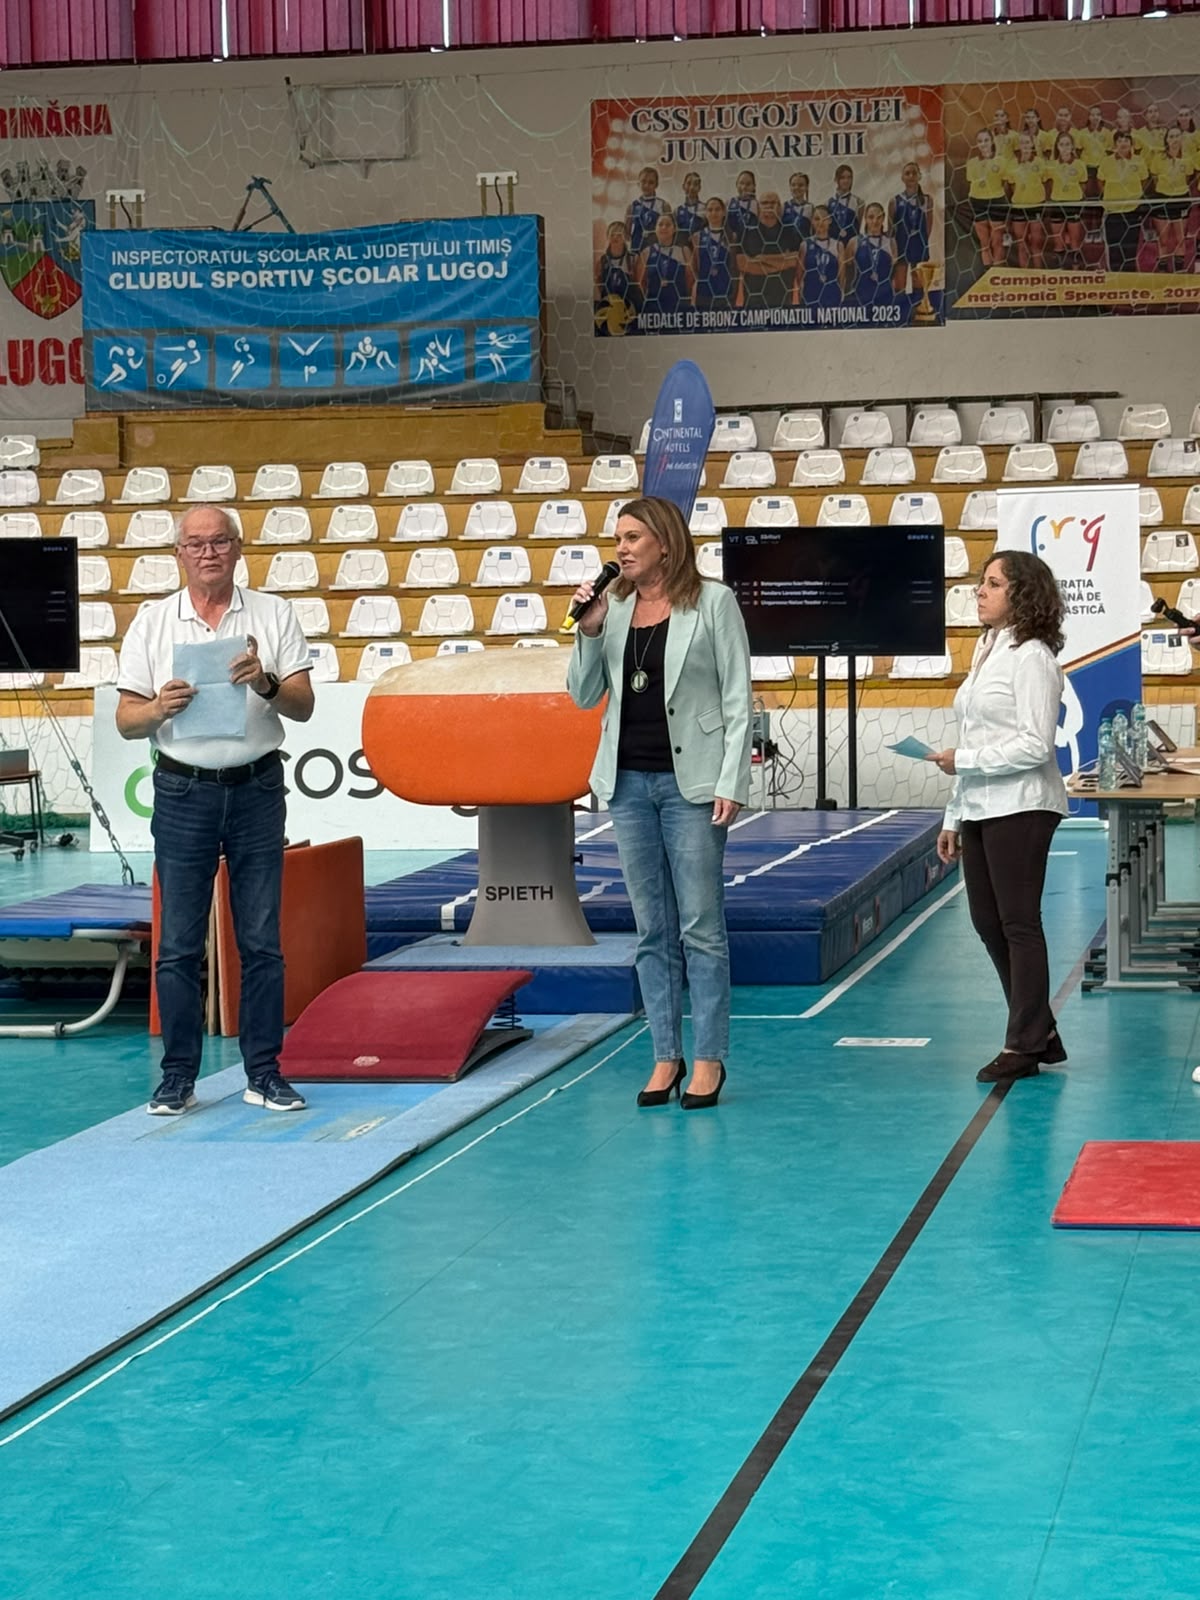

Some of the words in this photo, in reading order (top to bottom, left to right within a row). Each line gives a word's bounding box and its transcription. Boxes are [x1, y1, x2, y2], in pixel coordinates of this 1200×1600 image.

[631, 106, 689, 133] CSS
[697, 103, 801, 131] LUGOJ
[807, 98, 904, 126] VOLEI
[661, 133, 822, 164] JUNIOARE
[830, 132, 866, 156] III
[112, 250, 253, 265] INSPECTORATUL
[257, 247, 330, 268] ȘCOLAR
[334, 245, 358, 260] AL
[362, 241, 460, 262] JUDEȚULUI
[465, 239, 512, 257] TIMIȘ
[109, 271, 203, 290] CLUBUL
[210, 269, 314, 288] SPORTIV
[322, 265, 419, 292] ȘCOLAR
[427, 261, 509, 282] LUGOJ
[637, 312, 684, 329] MEDALIE
[686, 311, 702, 328] DE
[702, 310, 739, 327] BRONZ
[740, 307, 815, 327] CAMPIONATUL
[817, 306, 870, 327] NAȚIONAL
[871, 304, 901, 322] 2023
[1086, 591, 1101, 602] DE
[485, 885, 554, 901] SPIETH
